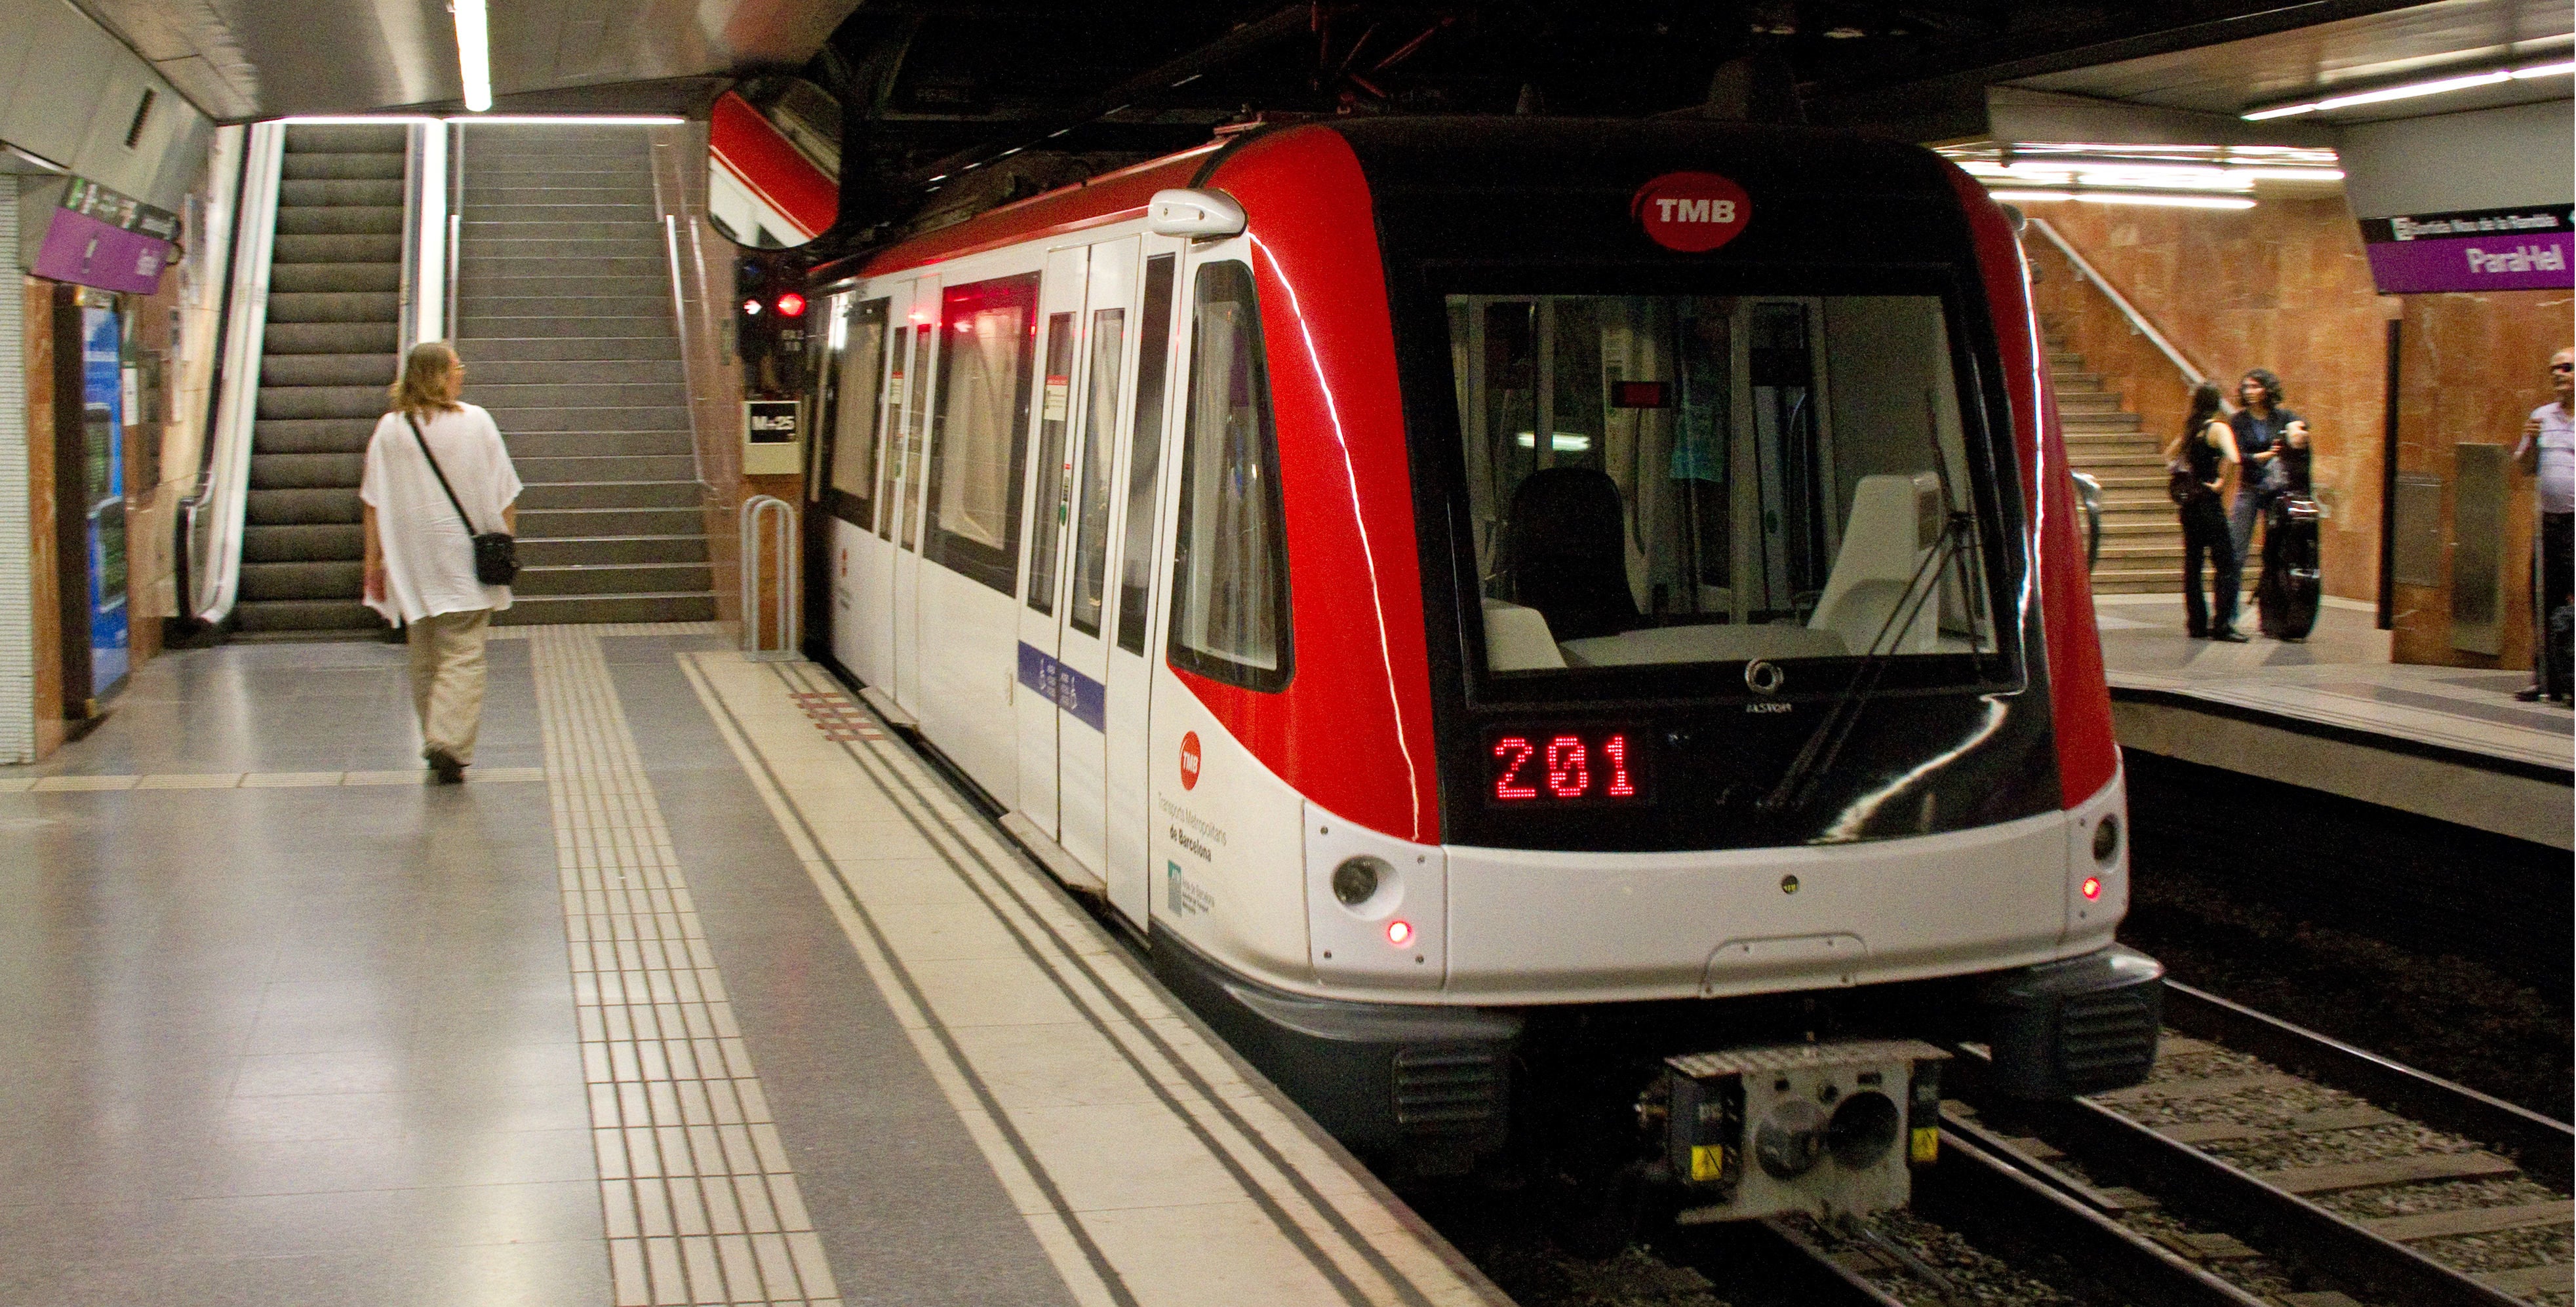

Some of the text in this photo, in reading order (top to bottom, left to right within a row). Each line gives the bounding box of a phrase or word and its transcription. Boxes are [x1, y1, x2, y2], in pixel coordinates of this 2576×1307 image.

[1655, 199, 1736, 223] TMB
[1183, 751, 1199, 773] TMB
[1495, 735, 1634, 798] 201
[1170, 824, 1212, 862] de Barcelona
[1185, 808, 1227, 846] Metropolitans
